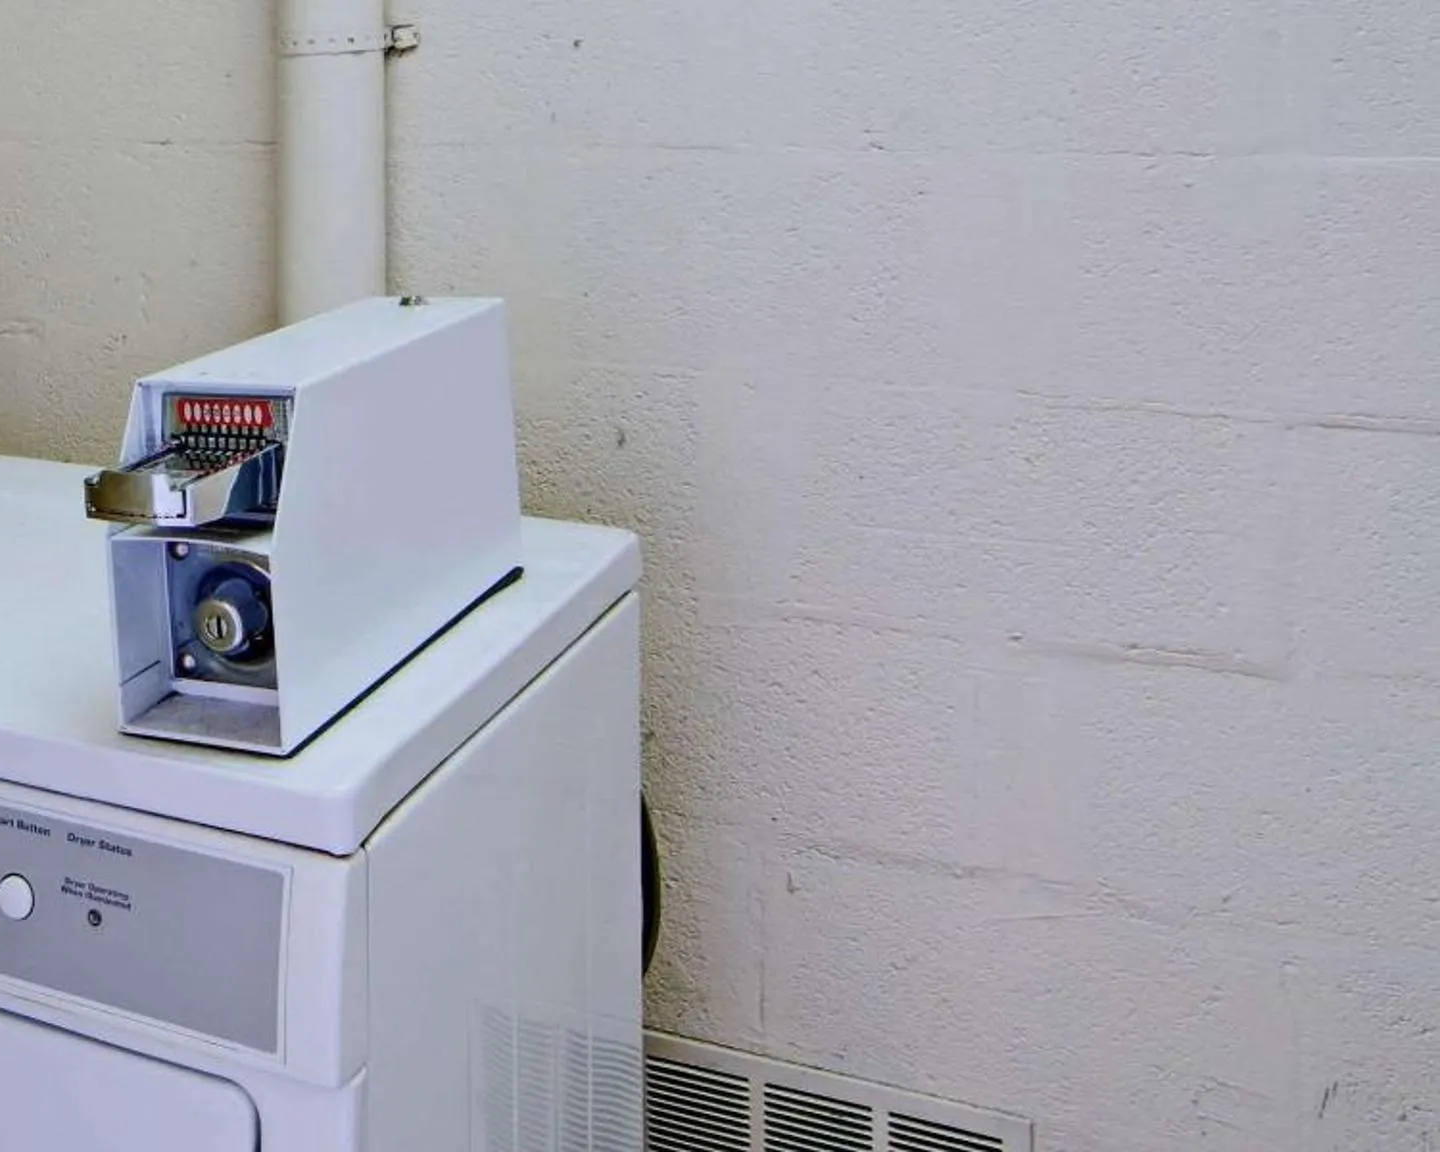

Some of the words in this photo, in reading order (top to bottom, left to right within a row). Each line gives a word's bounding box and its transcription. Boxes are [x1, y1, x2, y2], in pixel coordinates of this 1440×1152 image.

[17, 820, 51, 837] Button
[66, 833, 96, 847] Dryer
[98, 840, 133, 857] Status
